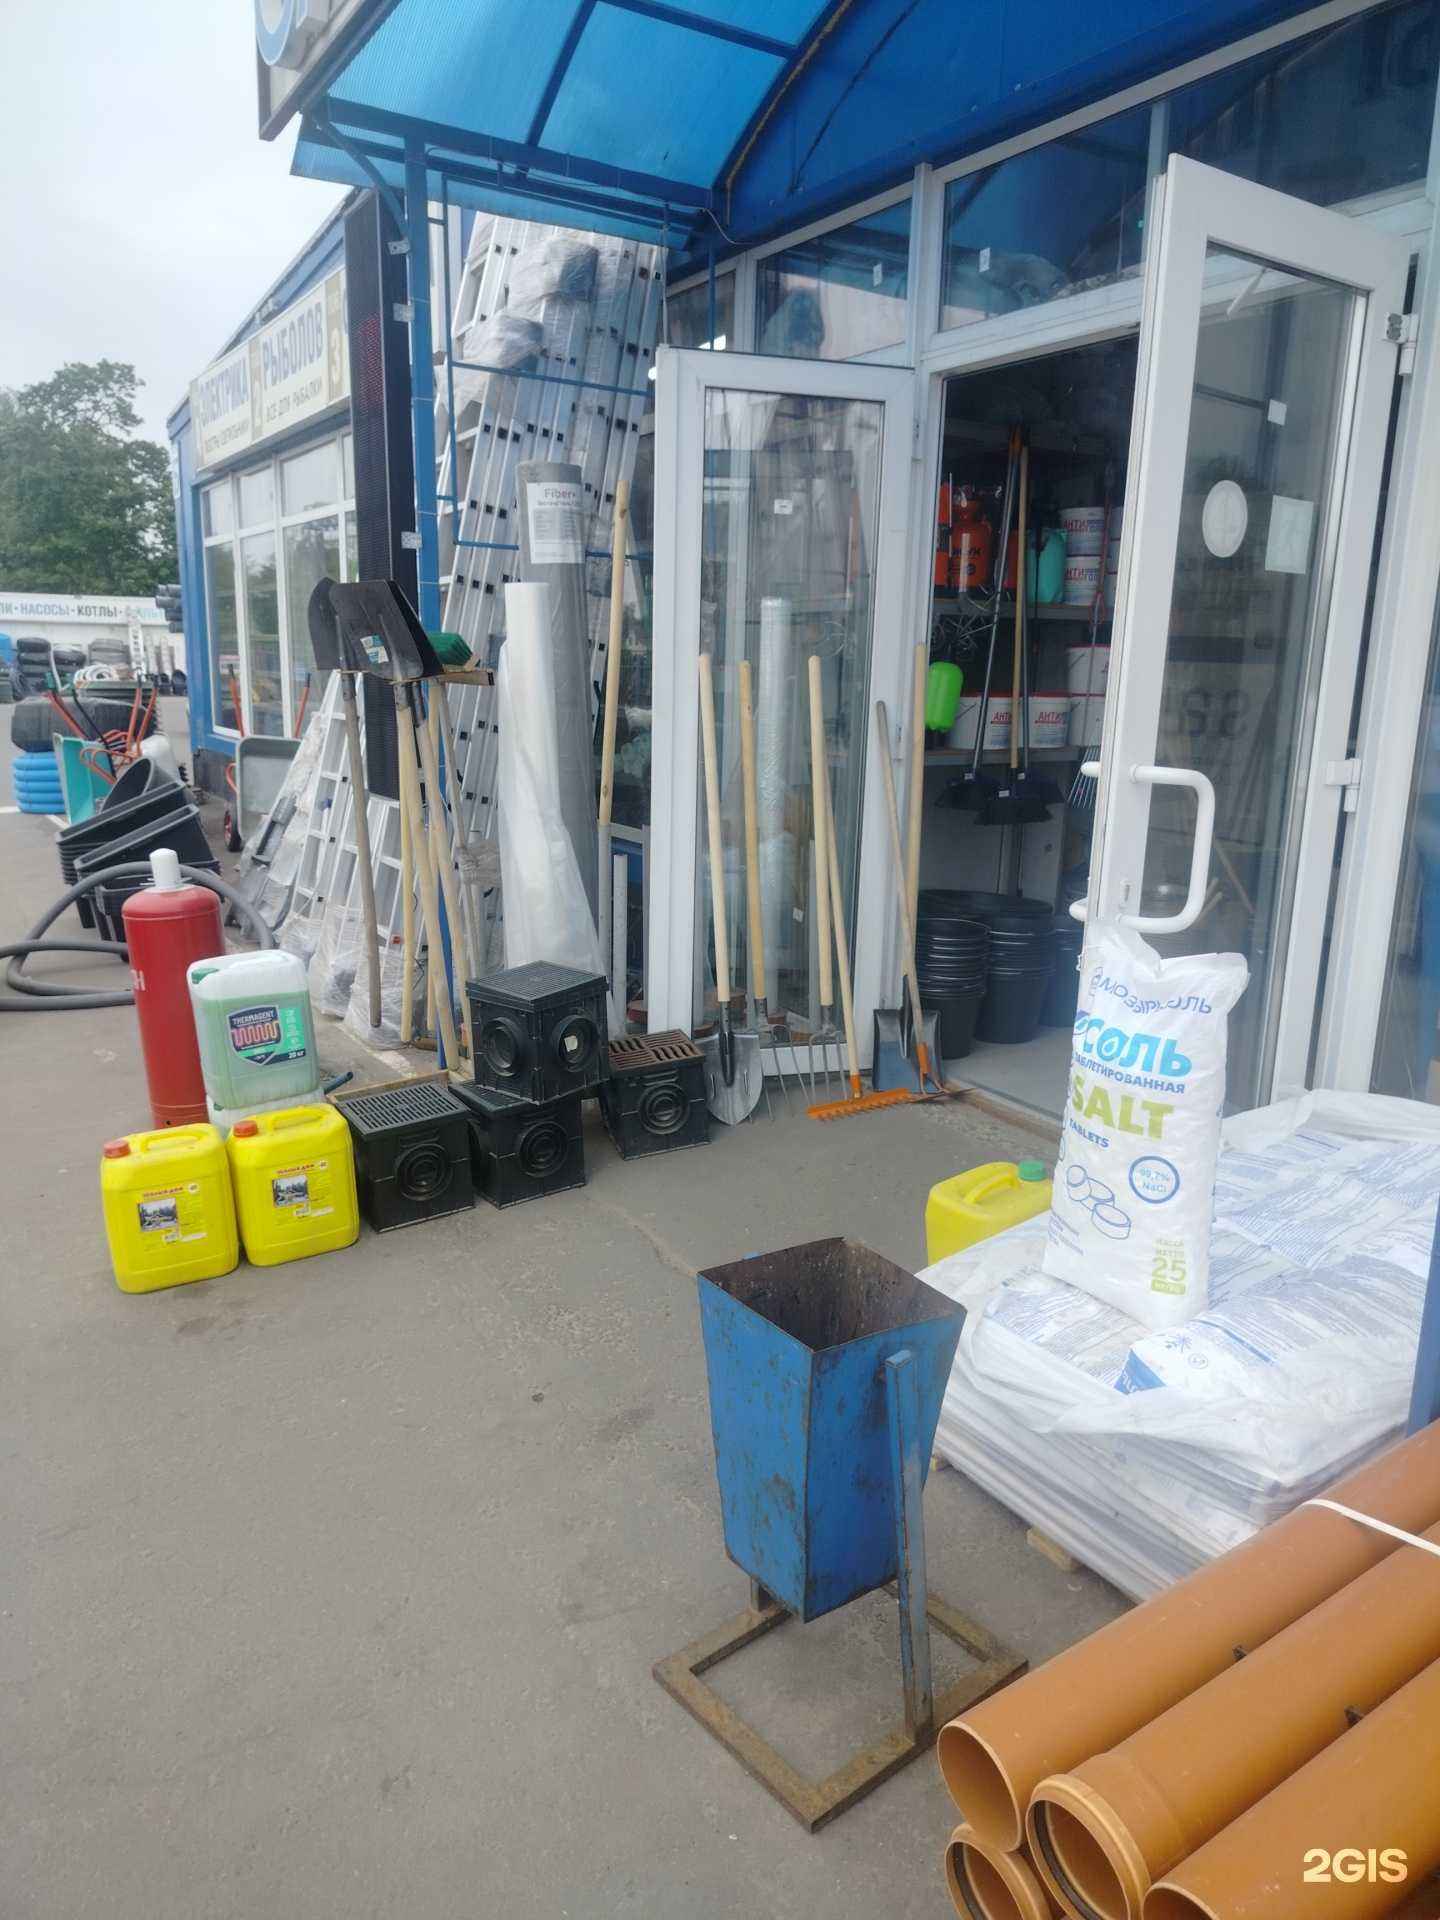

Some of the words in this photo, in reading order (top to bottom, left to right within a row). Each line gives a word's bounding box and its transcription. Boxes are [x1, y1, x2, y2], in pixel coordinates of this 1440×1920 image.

[263, 302, 323, 390] РЫБОЛОВ
[20, 603, 70, 616] НАСОСЫ
[77, 605, 117, 618] КОТЛЫ
[232, 1011, 274, 1025] THERMAGENT
[1083, 1018, 1193, 1078] СОЛЬ
[1072, 1075, 1174, 1139] SALT
[1070, 1118, 1109, 1148] TABLETS
[1152, 1257, 1186, 1282] 25
